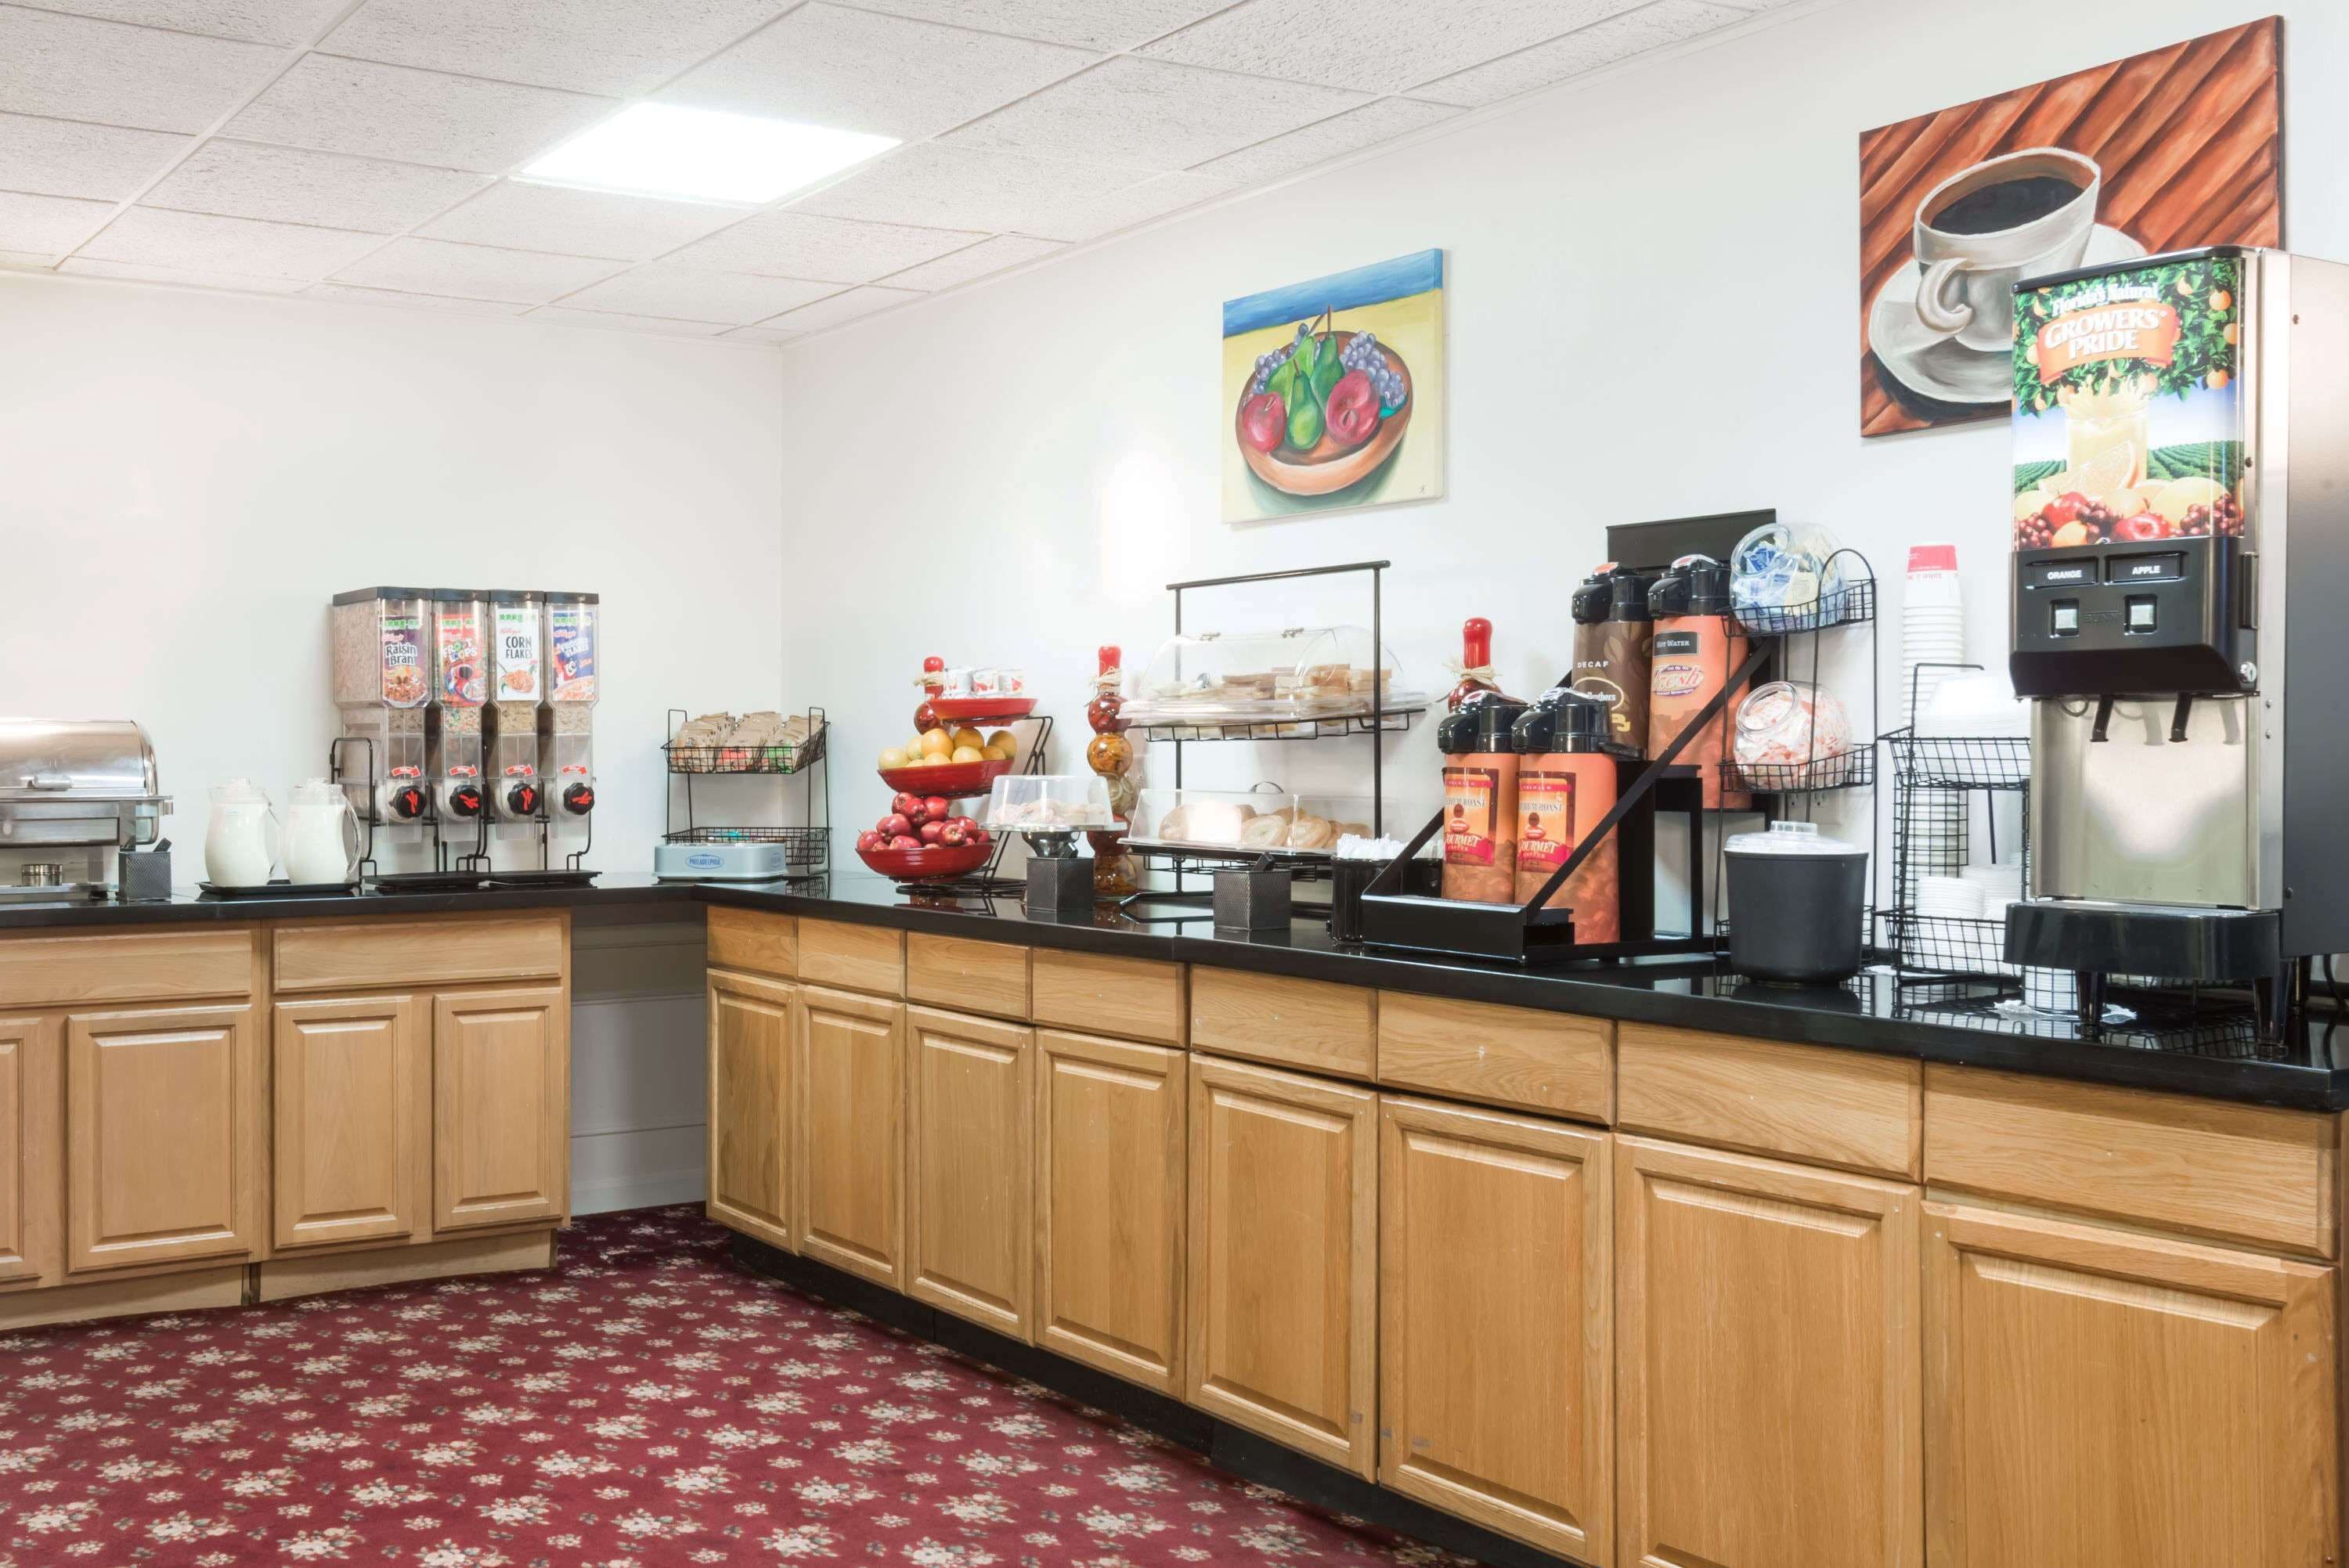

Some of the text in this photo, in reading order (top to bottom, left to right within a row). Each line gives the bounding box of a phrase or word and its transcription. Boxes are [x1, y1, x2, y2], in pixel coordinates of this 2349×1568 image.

[2051, 283, 2159, 316] Florida's Natural
[2068, 329, 2139, 359] PRIDE
[2047, 570, 2082, 580] ORANGE
[2131, 565, 2161, 575] APPLE
[505, 636, 532, 648] CORN
[386, 642, 417, 656] Raisin
[505, 649, 532, 658] FLAKES
[390, 655, 414, 665] Bran
